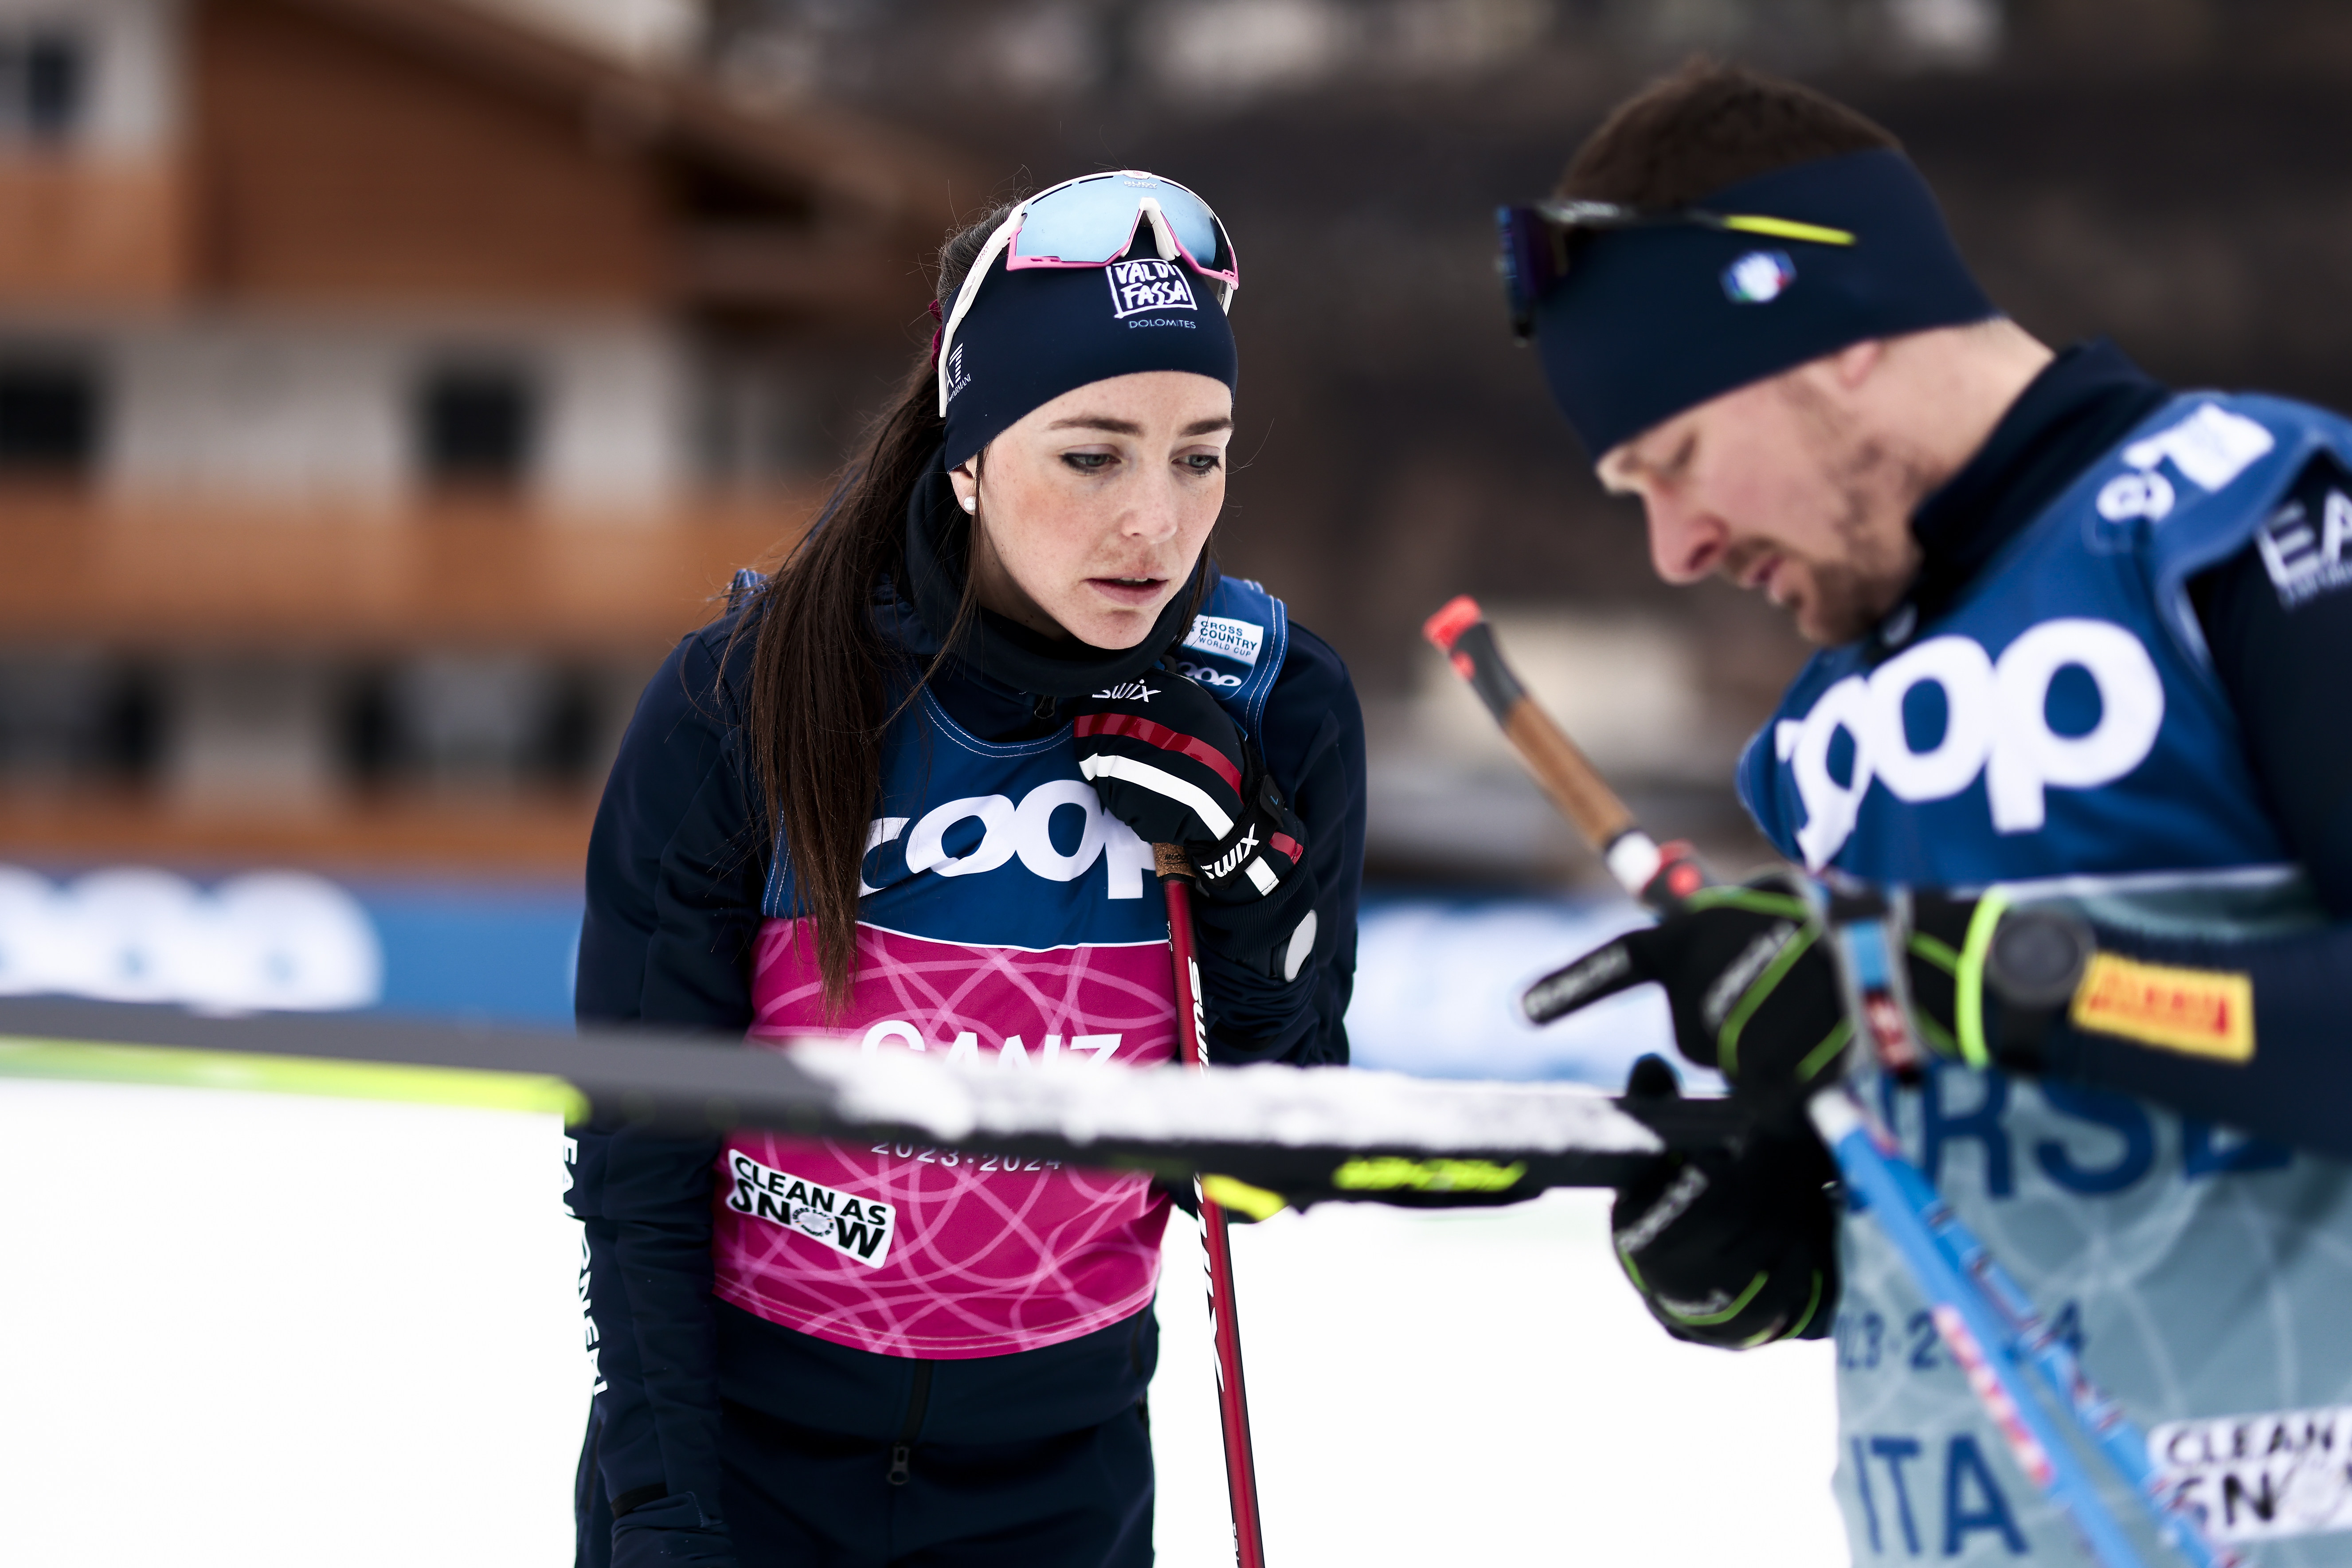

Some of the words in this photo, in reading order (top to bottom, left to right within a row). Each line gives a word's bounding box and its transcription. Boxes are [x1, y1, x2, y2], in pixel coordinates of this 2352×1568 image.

[1115, 262, 1157, 284] VAL
[1120, 279, 1189, 309] FASSA
[1128, 318, 1197, 329] DOLOMITES
[1200, 627, 1258, 651] COUNTRY
[1201, 621, 1243, 637] CROSS
[1199, 637, 1230, 651] WORLD
[1233, 646, 1252, 657] CUP
[735, 1157, 835, 1213] CLEAN
[840, 1198, 886, 1226] AS
[1851, 1433, 2030, 1559] ITA
